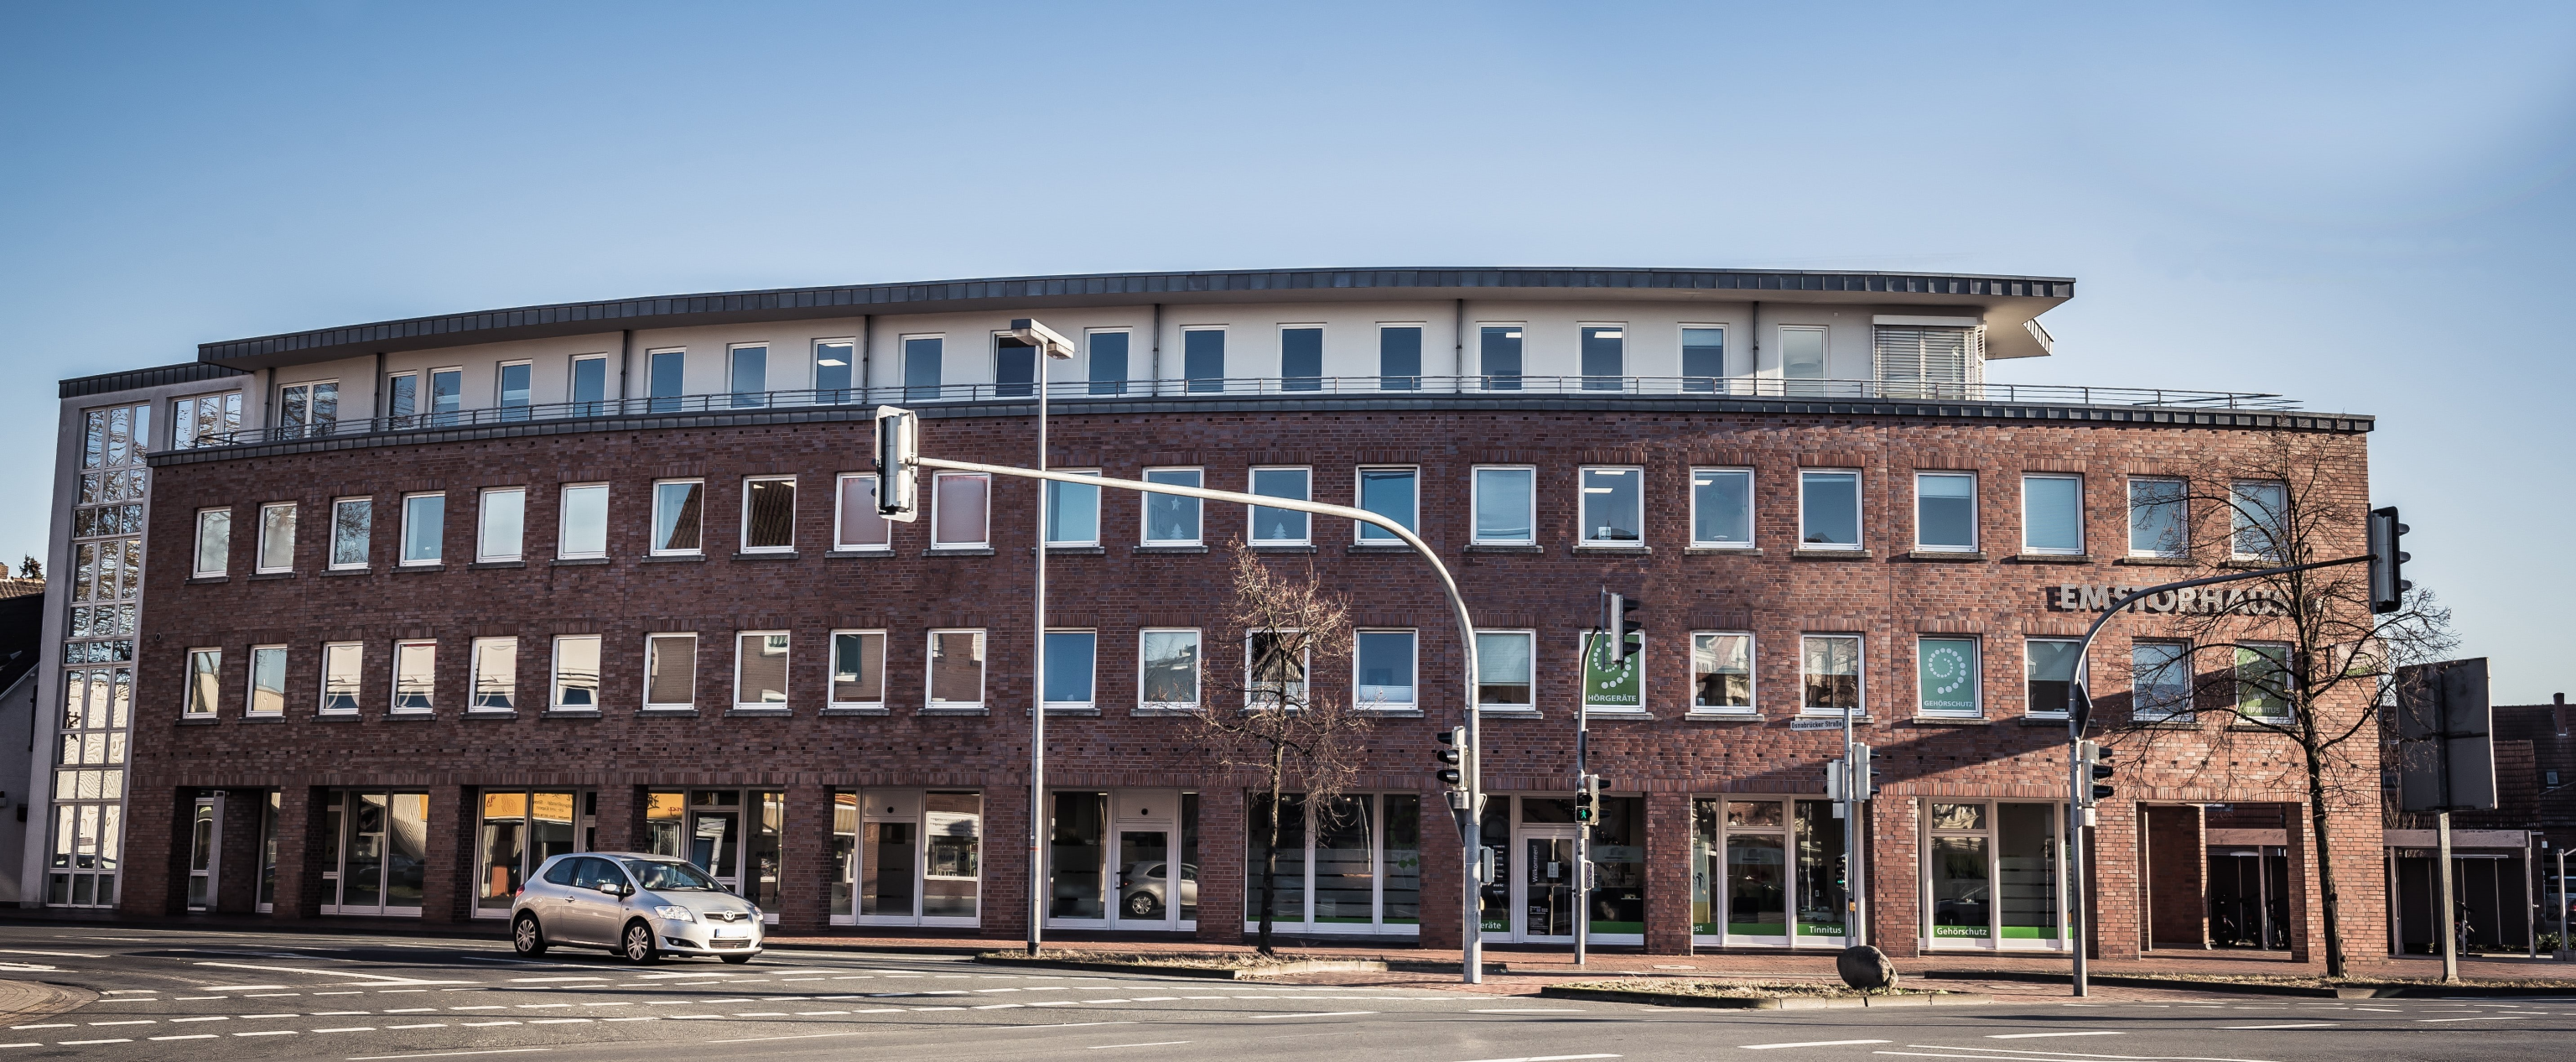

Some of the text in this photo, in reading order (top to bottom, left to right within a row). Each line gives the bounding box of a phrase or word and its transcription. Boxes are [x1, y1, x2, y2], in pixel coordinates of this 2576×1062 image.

[1587, 693, 1637, 702] HÖRGERÄTE
[1924, 699, 1973, 707] GEHÖRSCHUTZ
[1791, 721, 1824, 729] Osnabrücker
[1809, 925, 1842, 934] Tinnitus
[1936, 927, 1987, 935] Gehörschutz
